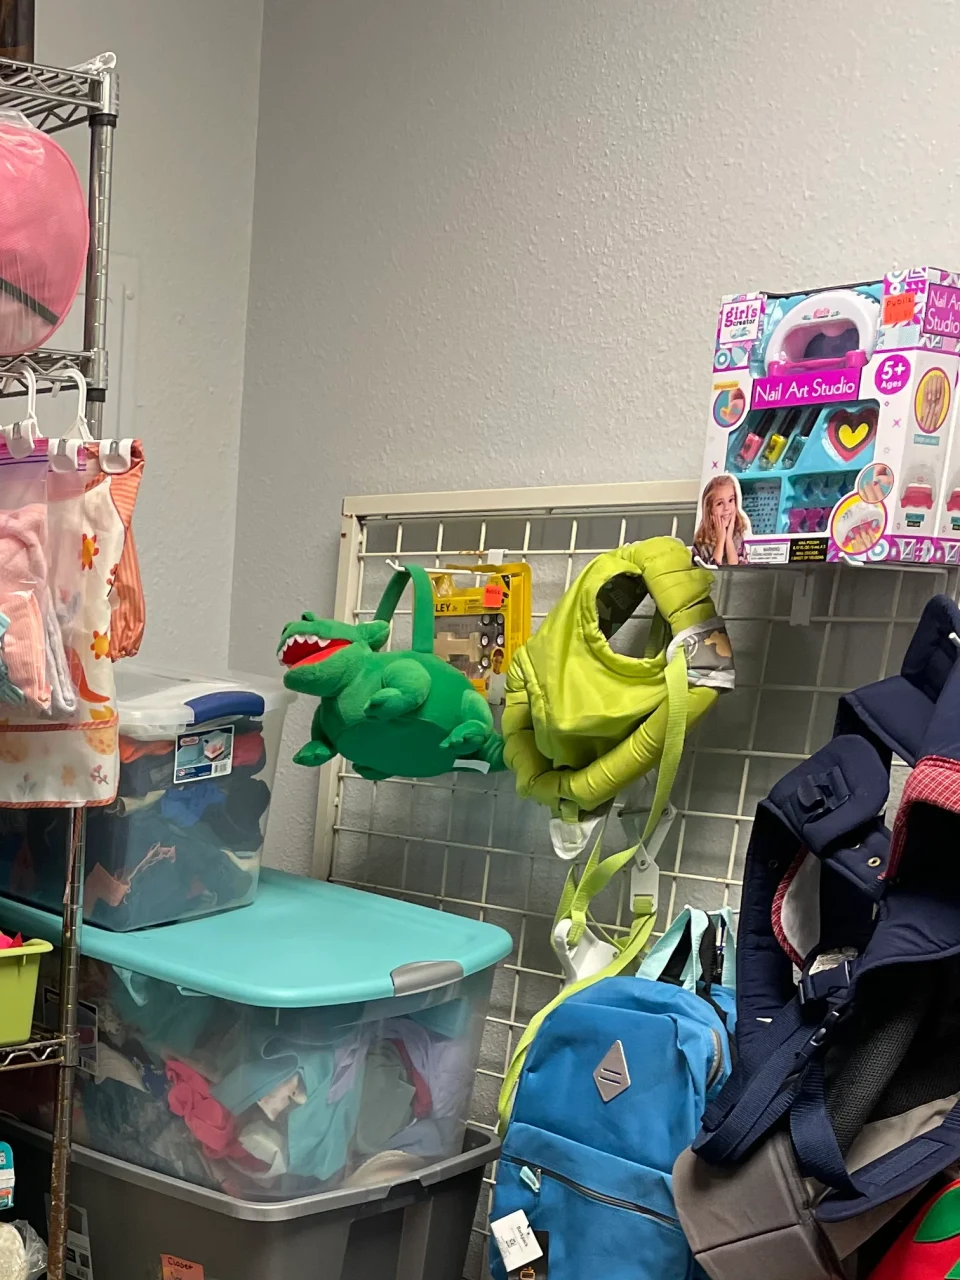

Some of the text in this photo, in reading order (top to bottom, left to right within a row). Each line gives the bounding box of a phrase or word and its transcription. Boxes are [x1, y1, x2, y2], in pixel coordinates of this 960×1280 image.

[929, 289, 947, 308] Nail
[948, 295, 960, 311] Ar
[724, 304, 758, 328] girl's
[926, 308, 960, 334] Studio
[881, 361, 906, 380] 5+
[754, 383, 783, 402] Nail
[784, 381, 809, 400] Art
[811, 376, 856, 397] Studio
[880, 379, 902, 390] Ages
[167, 1256, 194, 1270] Closet
